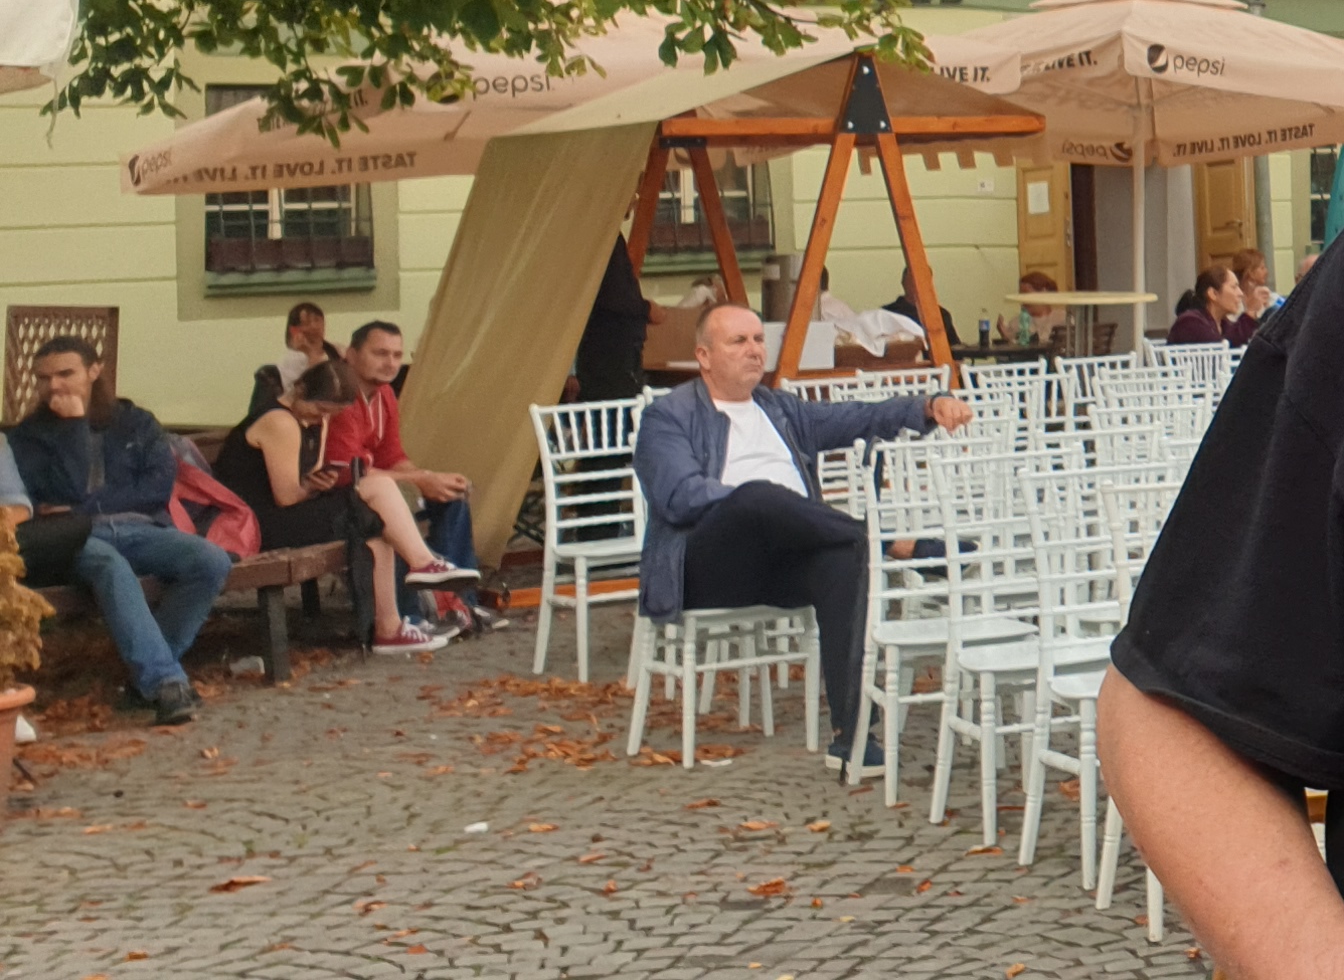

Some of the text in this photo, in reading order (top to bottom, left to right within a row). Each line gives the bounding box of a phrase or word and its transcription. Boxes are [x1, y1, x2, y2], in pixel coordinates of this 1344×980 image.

[929, 66, 991, 83] IVE IT.
[1173, 54, 1226, 77] pepsi
[472, 73, 552, 101] pepsi
